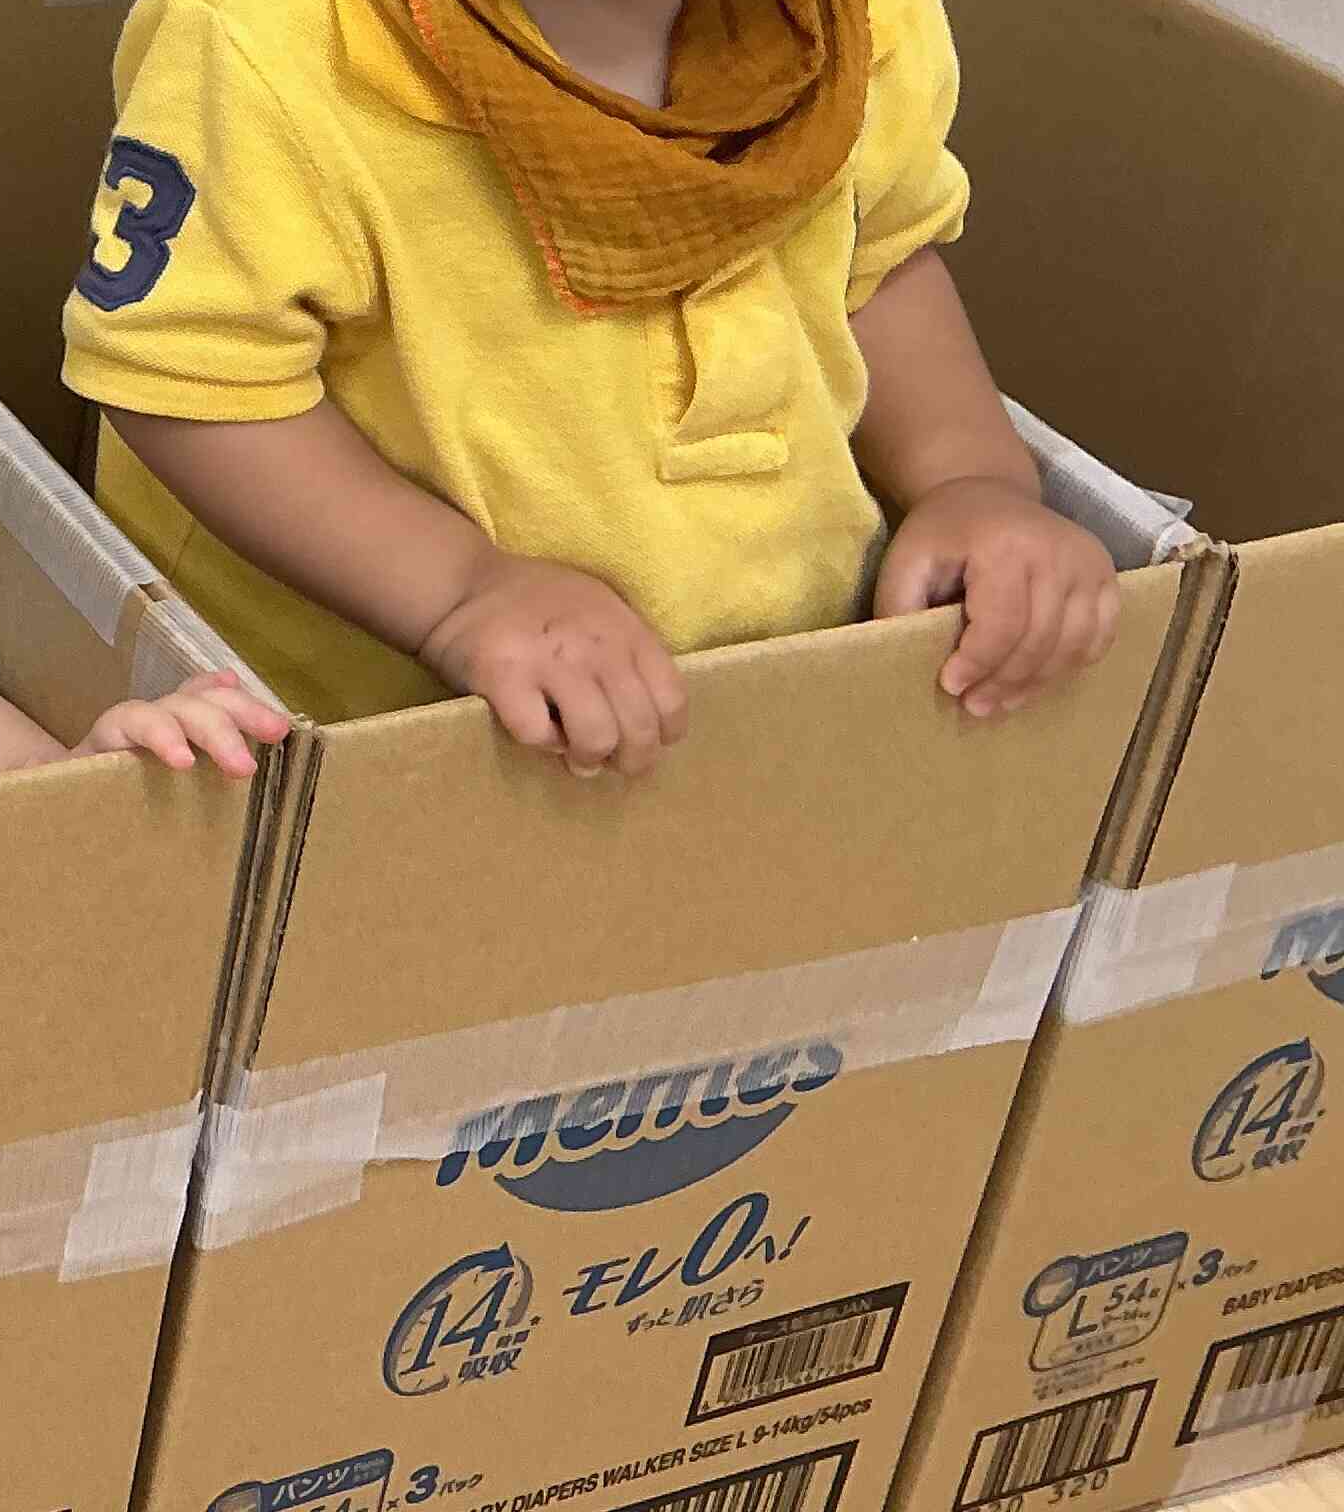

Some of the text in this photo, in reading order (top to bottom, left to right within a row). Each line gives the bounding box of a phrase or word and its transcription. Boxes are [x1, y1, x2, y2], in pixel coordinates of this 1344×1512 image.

[78, 136, 196, 313] 3
[1202, 1065, 1310, 1162] 14
[398, 1271, 514, 1377] 14
[511, 1473, 600, 1512] DIAPERS
[601, 1447, 687, 1488] WALKER
[688, 1434, 734, 1463] SIZE
[736, 1430, 748, 1449] L
